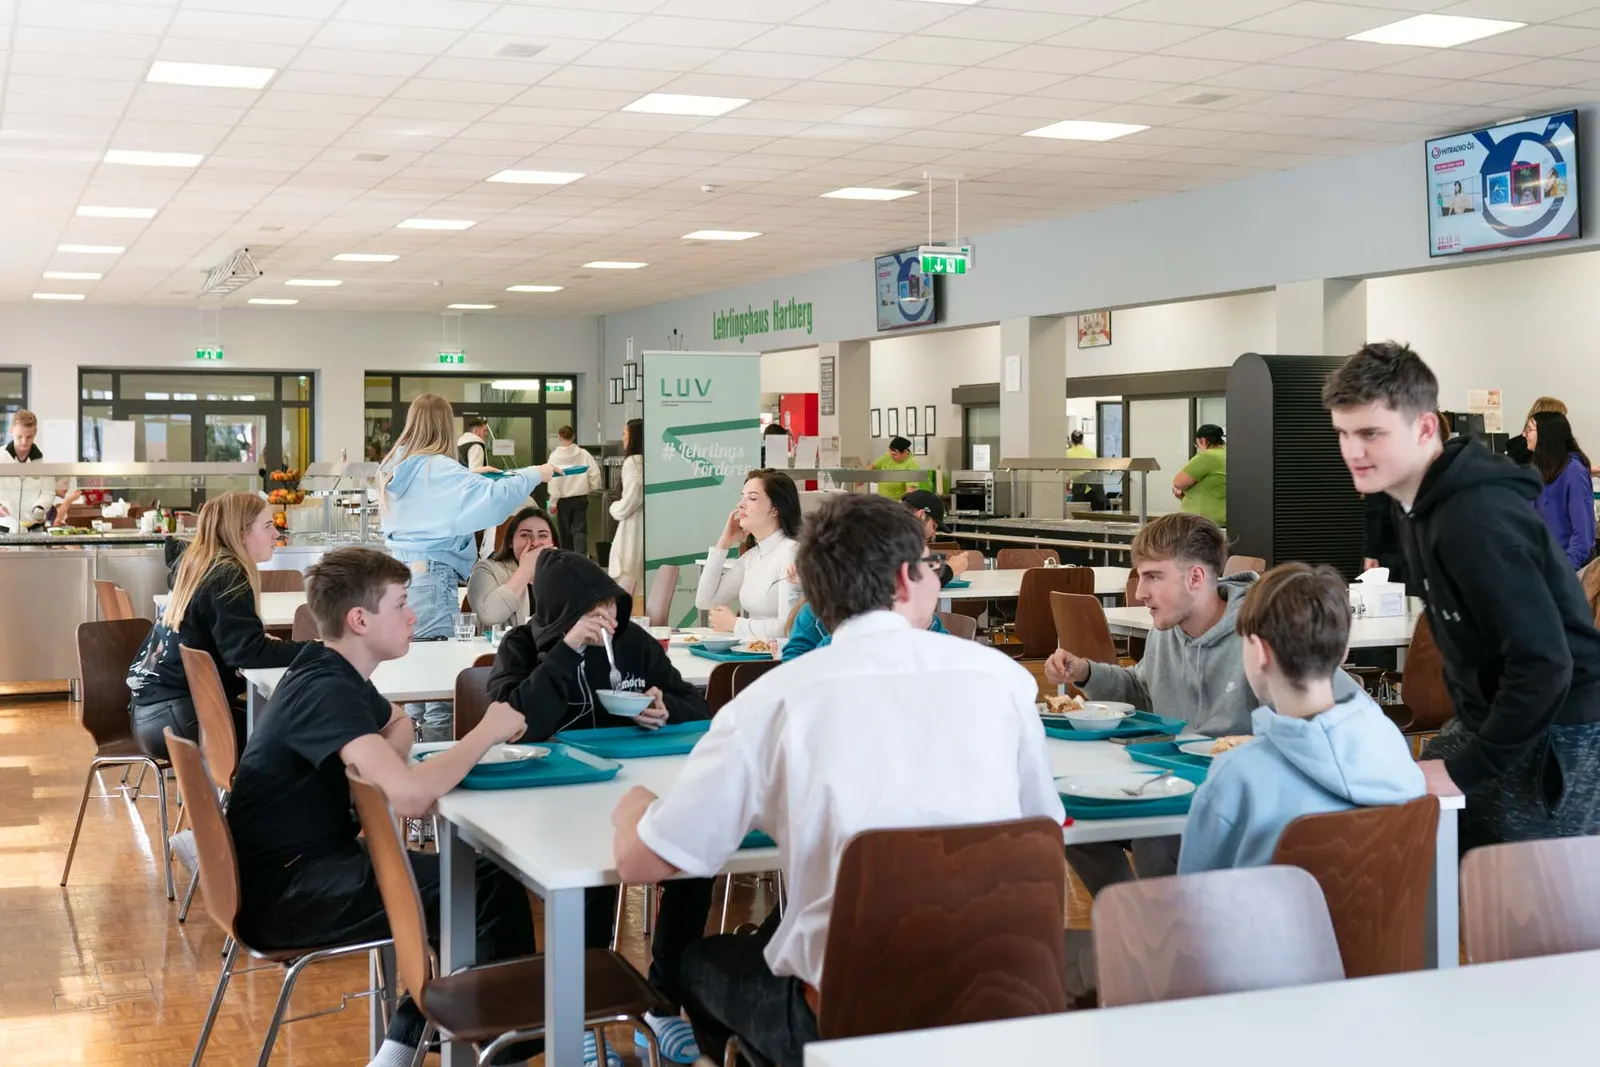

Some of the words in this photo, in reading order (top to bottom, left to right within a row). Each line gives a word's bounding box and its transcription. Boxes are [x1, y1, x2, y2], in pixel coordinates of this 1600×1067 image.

[1442, 143, 1466, 155] HITRADIO
[713, 304, 769, 343] Lehrlingshaus
[773, 296, 813, 335] Hartberg
[660, 377, 712, 398] LUV
